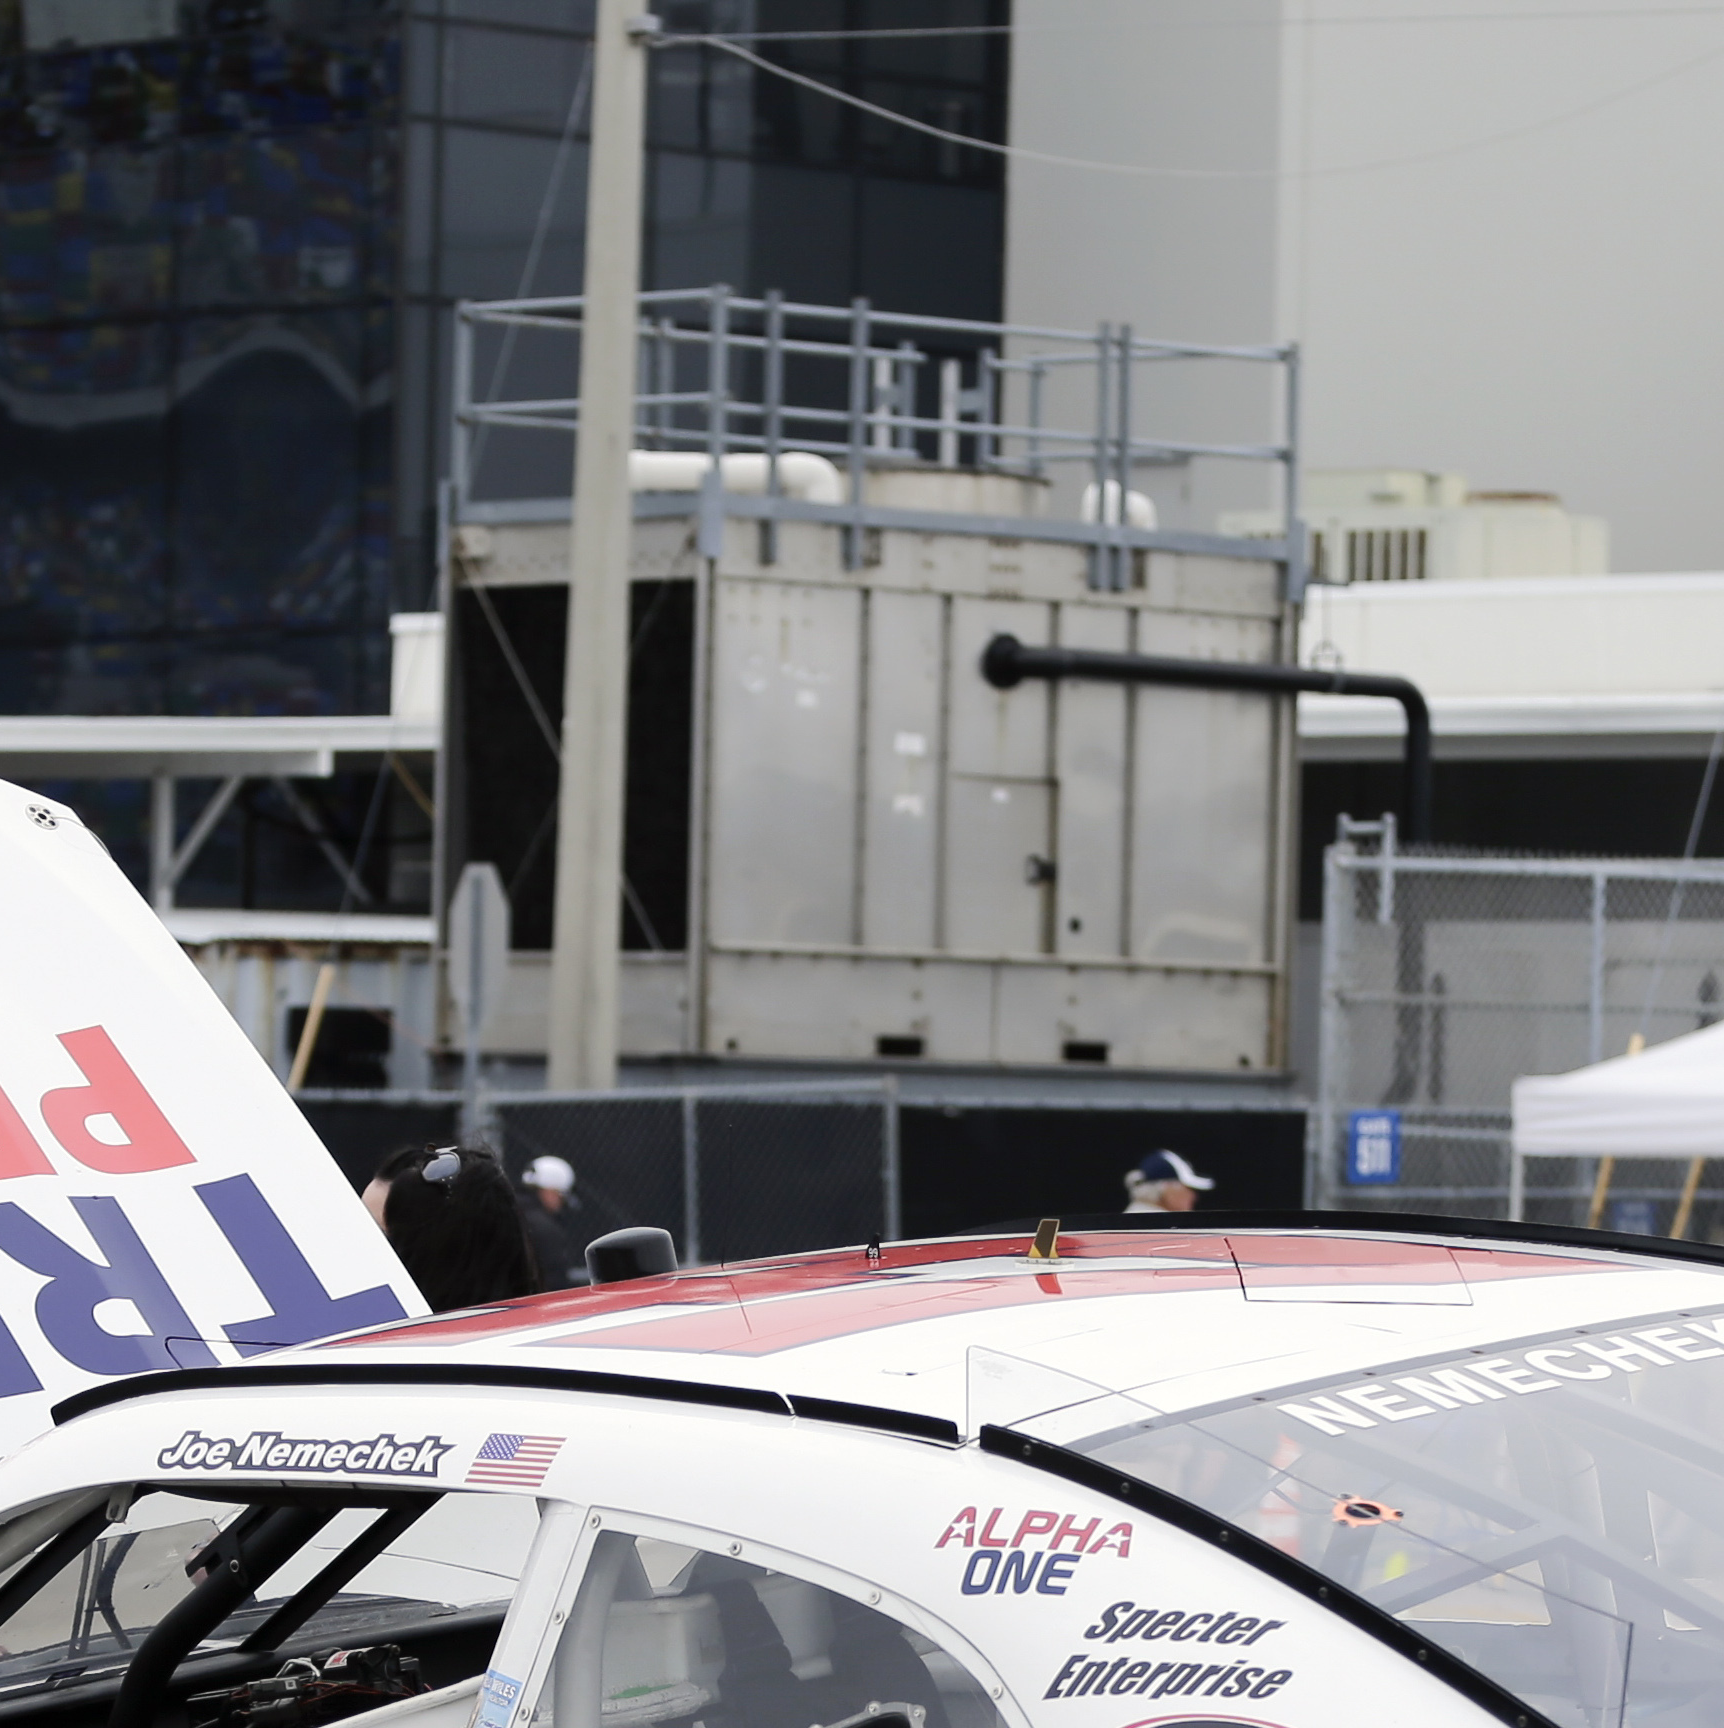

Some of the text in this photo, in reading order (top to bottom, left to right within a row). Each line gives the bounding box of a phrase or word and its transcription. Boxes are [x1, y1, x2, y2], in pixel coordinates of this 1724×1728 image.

[161, 1433, 444, 1473] Joe Nemechek
[933, 1505, 1134, 1559] ALPHA
[960, 1549, 1082, 1596] ONE
[1082, 1600, 1289, 1647] Specter
[1041, 1653, 1294, 1701] Enterprise
